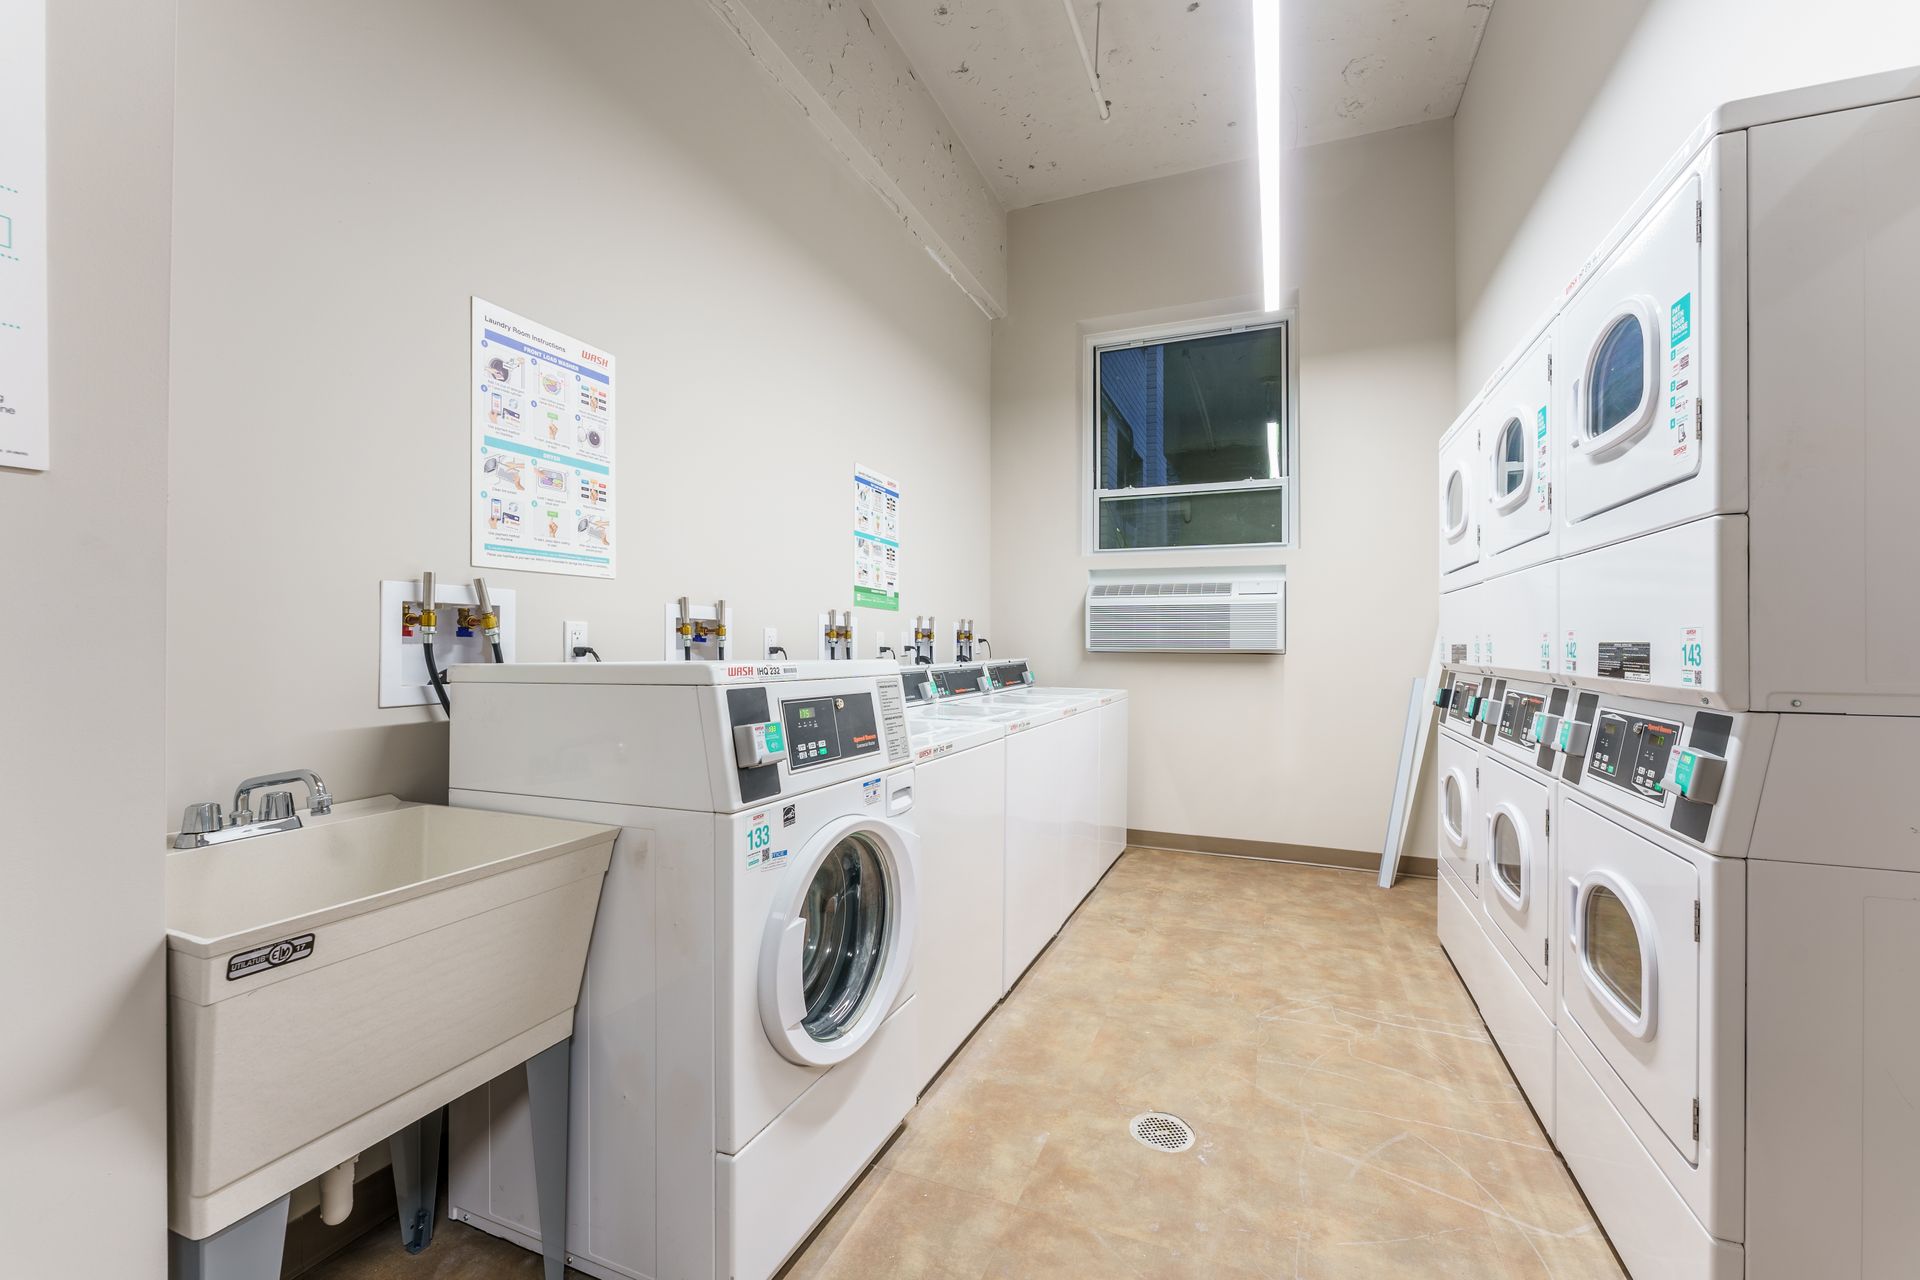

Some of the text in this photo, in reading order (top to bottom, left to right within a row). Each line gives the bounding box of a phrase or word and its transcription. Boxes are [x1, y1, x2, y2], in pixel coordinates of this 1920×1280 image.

[484, 315, 567, 353] Laundry Room Instructions
[523, 345, 580, 373] FRONT LOAD WASHER
[581, 350, 609, 368] WASH
[1565, 641, 1577, 659] 142
[1681, 643, 1702, 667] 143
[727, 666, 754, 677] WASH
[769, 666, 781, 675] 232
[747, 824, 770, 851] 133
[231, 956, 266, 971] UTILATUB
[296, 944, 307, 953] 17
